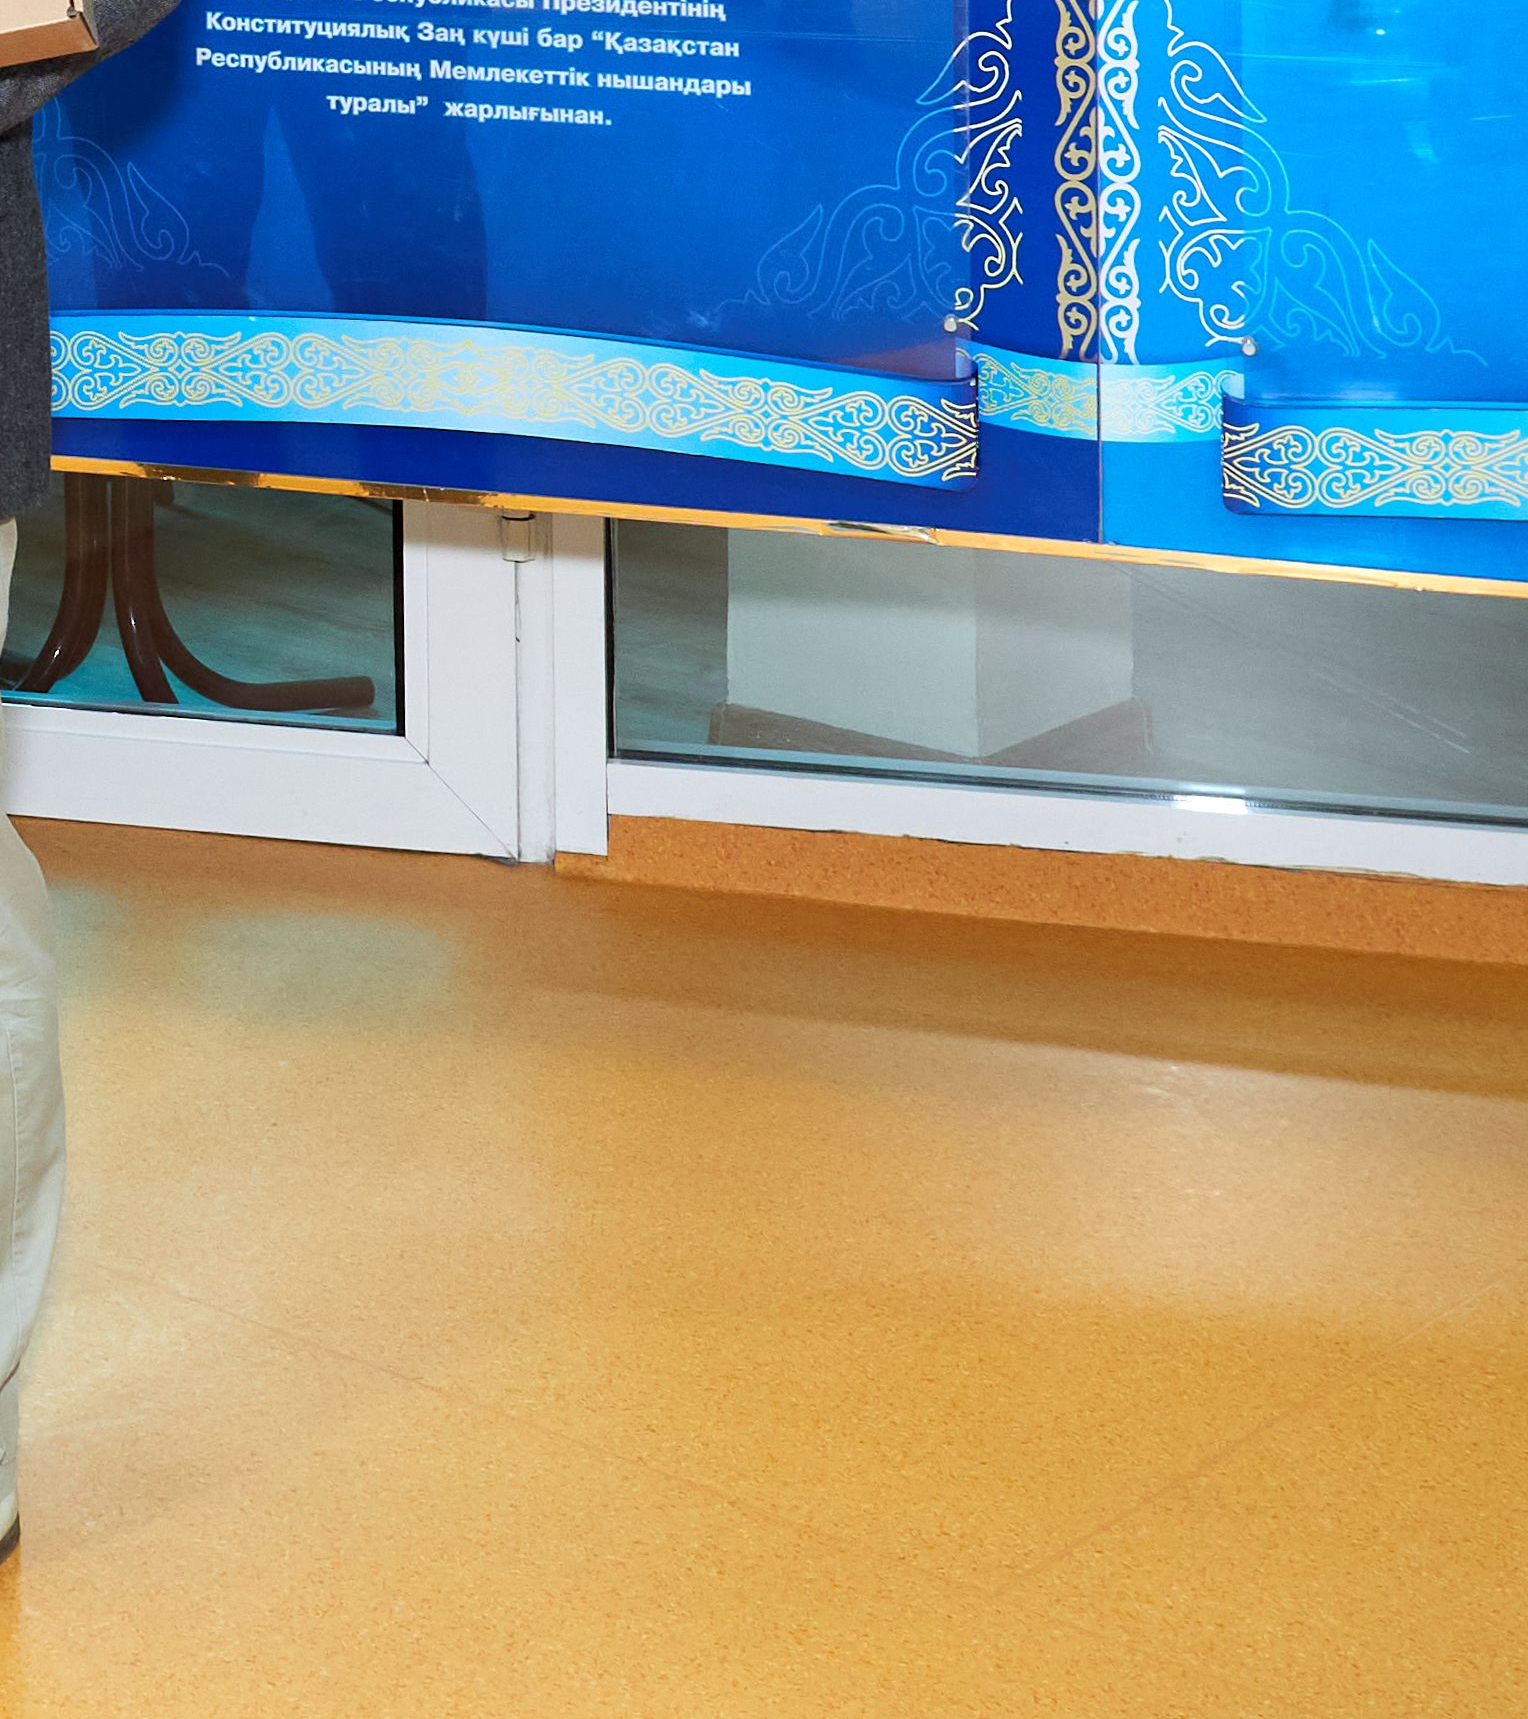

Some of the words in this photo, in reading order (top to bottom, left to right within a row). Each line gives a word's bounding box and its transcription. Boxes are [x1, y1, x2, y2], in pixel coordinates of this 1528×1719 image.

[206, 12, 411, 42] Конституциялық
[417, 21, 466, 46] Заң
[473, 27, 529, 49] күші
[536, 27, 584, 52] бар
[591, 31, 740, 57] “Қазақстан
[196, 48, 422, 79] Республикасының
[430, 60, 590, 86] Мемлекеттік
[597, 73, 752, 98] нышандары
[326, 95, 429, 115] туралы”
[444, 102, 612, 125] жарлығынан.
